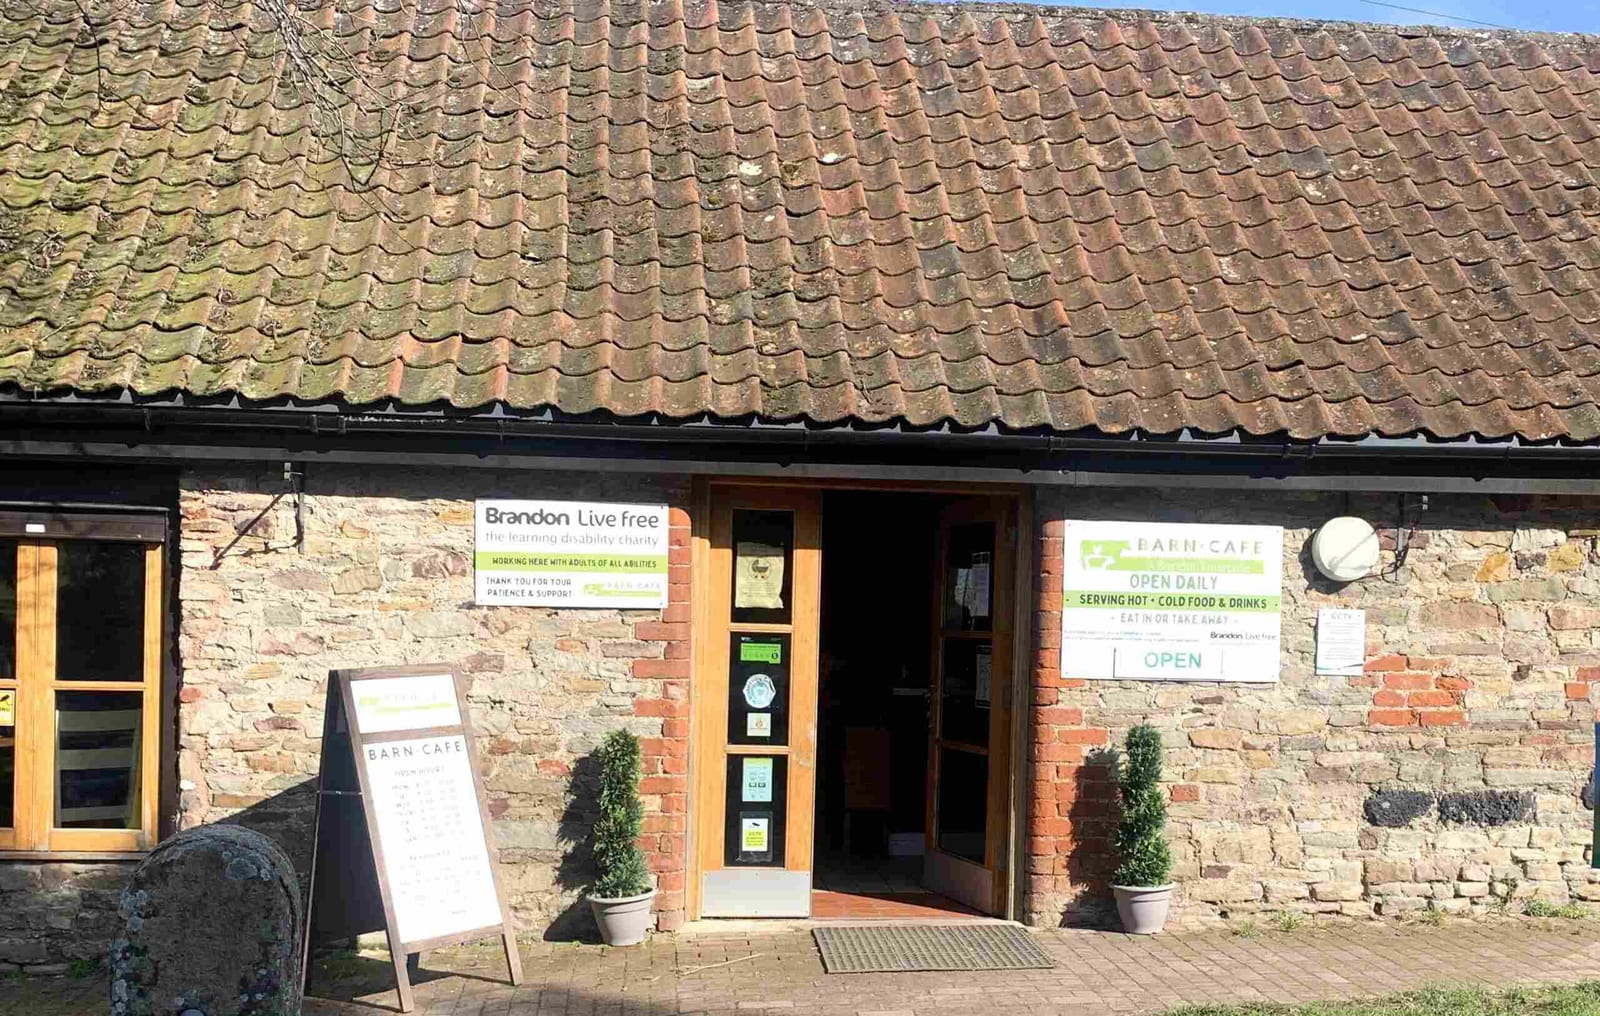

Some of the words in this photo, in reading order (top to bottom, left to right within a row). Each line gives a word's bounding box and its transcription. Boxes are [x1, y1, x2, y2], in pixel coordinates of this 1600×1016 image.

[485, 507, 570, 526] Brandon
[578, 509, 617, 527] Live
[621, 510, 660, 528] free
[485, 531, 505, 543] the
[508, 531, 557, 546] learning
[561, 532, 615, 546] disability
[618, 533, 659, 547] charity
[1137, 537, 1197, 553] BARN
[1209, 539, 1265, 555] CAFE
[492, 557, 527, 566] WORKING
[528, 557, 549, 567] HERE
[550, 558, 568, 567] WITH
[568, 558, 597, 568] ADULTS
[598, 559, 608, 568] OF
[609, 559, 622, 568] ALL
[624, 559, 657, 569] ABILITIES
[486, 577, 512, 585] THANK
[515, 577, 531, 586] YOU
[532, 578, 549, 586] FOR
[550, 578, 572, 586] YOUR
[1129, 573, 1171, 589] OPEN
[1175, 575, 1218, 590] DAILY
[487, 589, 525, 597] PATIENCE
[536, 590, 573, 598] SUPPORT
[1079, 594, 1125, 606] SERVING
[1127, 595, 1148, 606] HOT
[1158, 596, 1186, 607] COLD
[1187, 596, 1216, 608] FOOD
[1218, 598, 1227, 608] &
[1229, 597, 1268, 609] DRINKS
[1120, 612, 1140, 624] EAT
[1142, 613, 1152, 624] IN
[1155, 614, 1169, 624] OR
[1172, 614, 1199, 625] TAKE
[1200, 615, 1229, 625] AWAY
[1210, 631, 1243, 640] Brandon
[1245, 631, 1260, 640] Live
[1261, 632, 1277, 641] free
[1144, 651, 1202, 669] OPEN
[368, 745, 414, 761] BARN
[421, 740, 462, 755] CAFE
